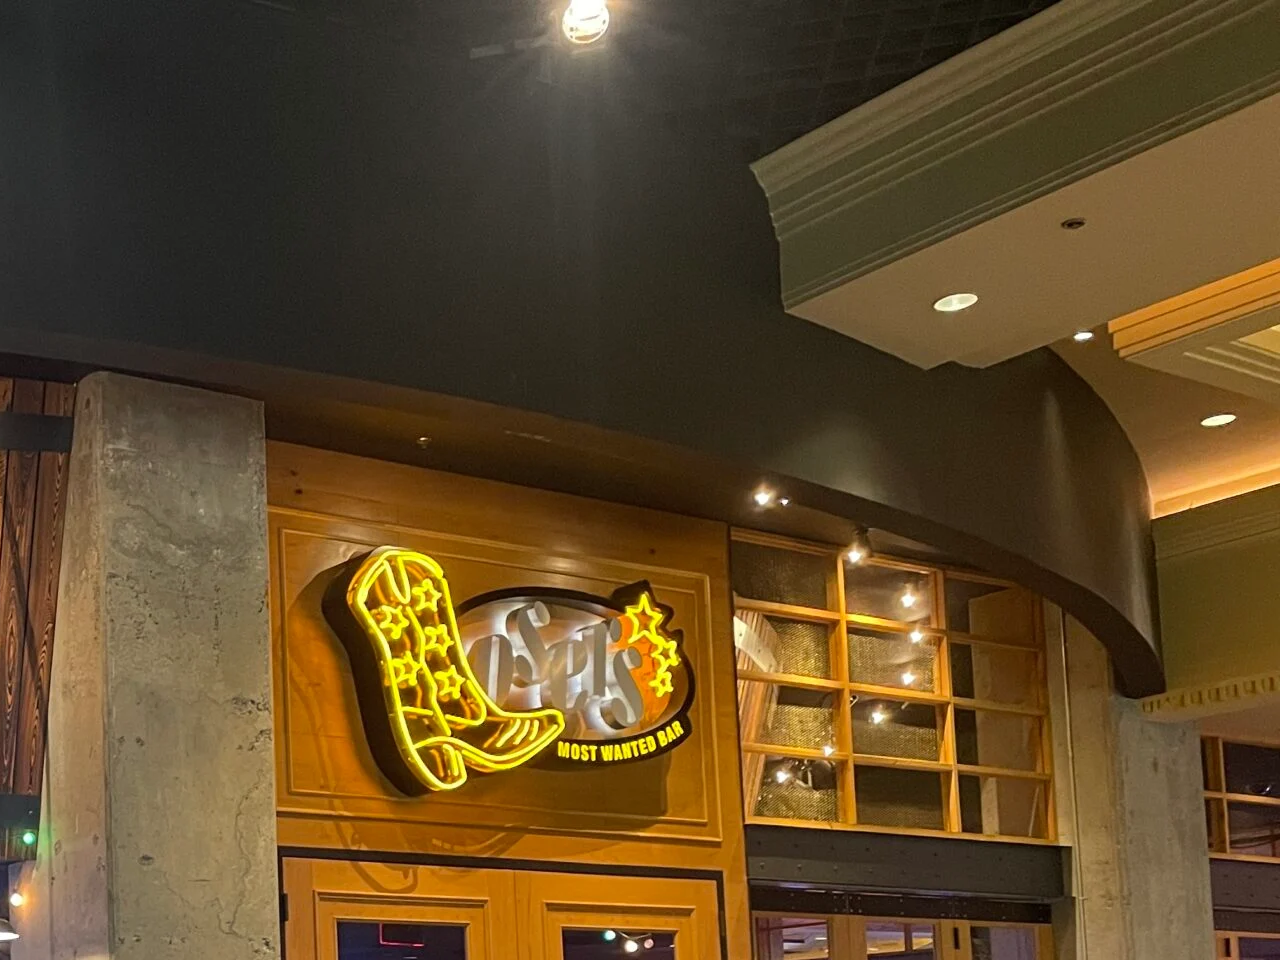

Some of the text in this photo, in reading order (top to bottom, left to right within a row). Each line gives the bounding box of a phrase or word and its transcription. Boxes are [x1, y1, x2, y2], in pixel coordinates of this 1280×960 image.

[557, 720, 684, 762] MOST WANTED BAR
